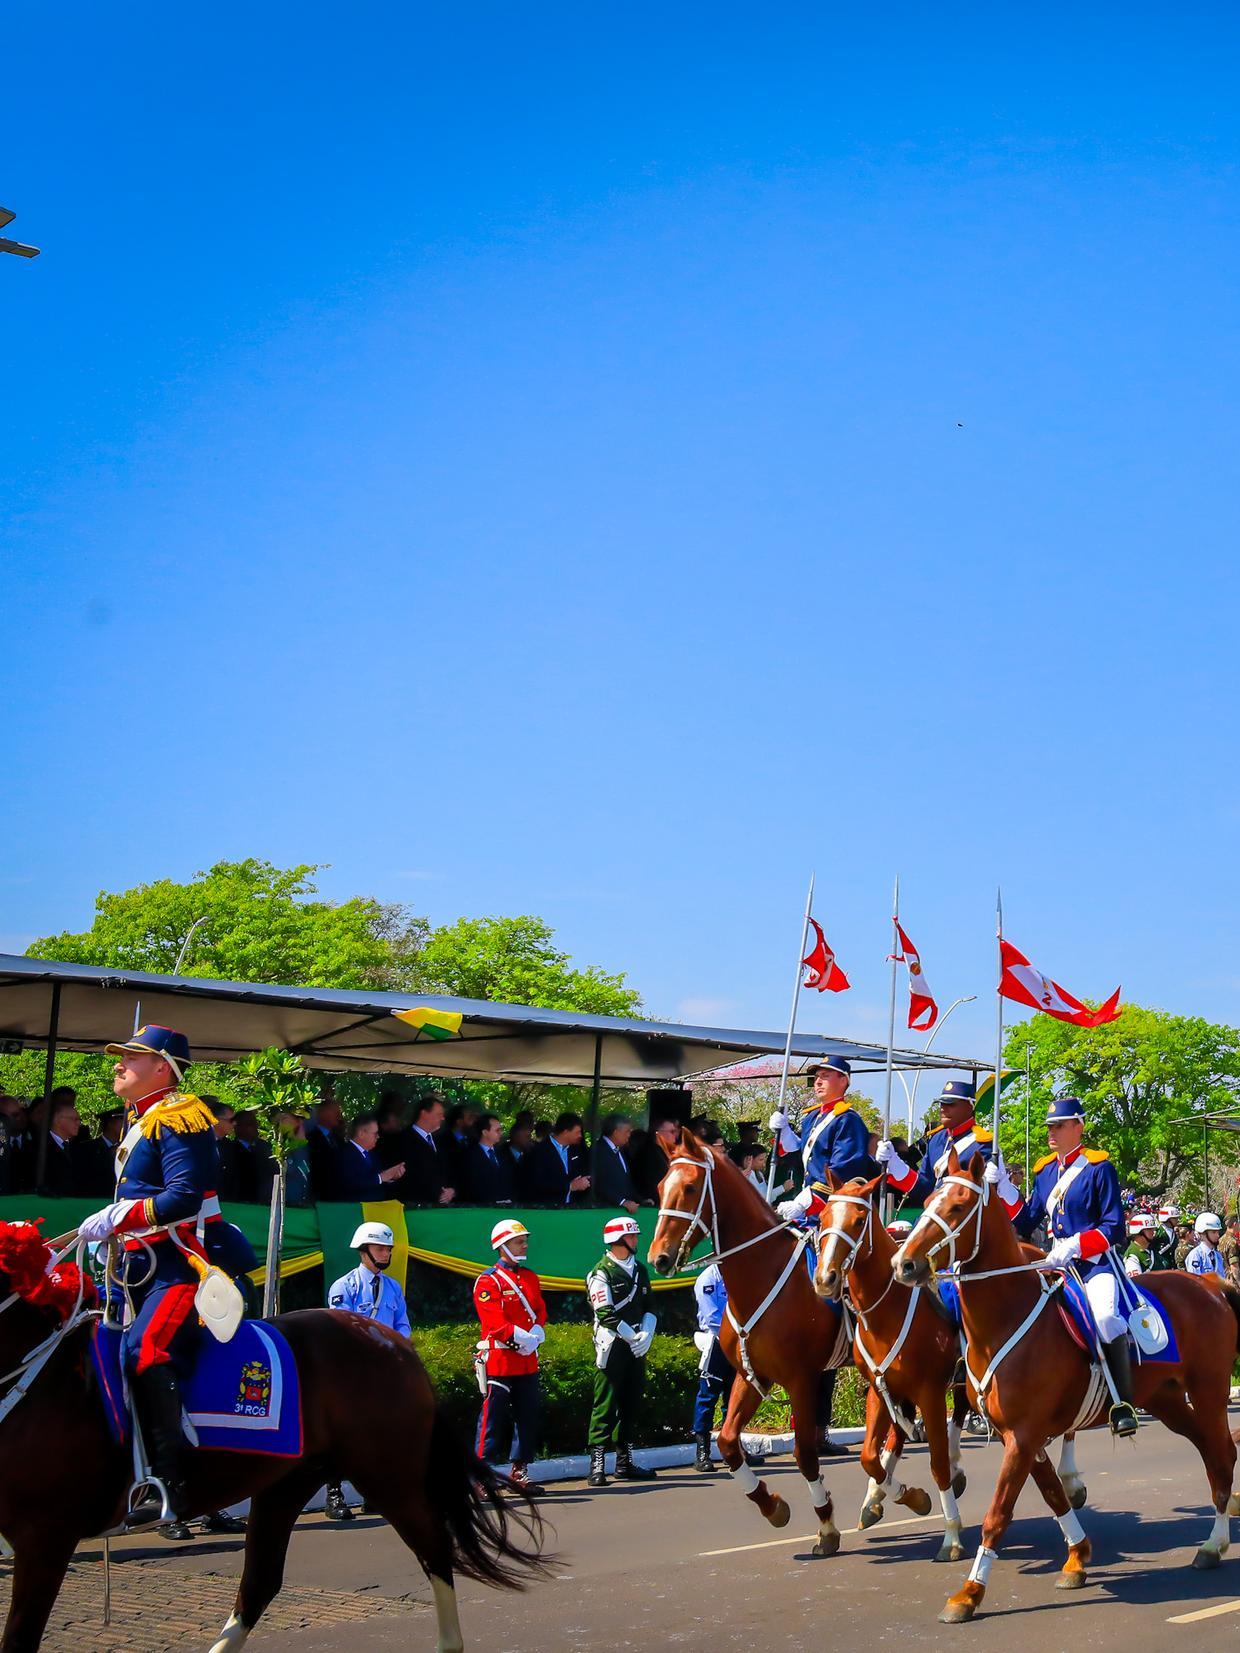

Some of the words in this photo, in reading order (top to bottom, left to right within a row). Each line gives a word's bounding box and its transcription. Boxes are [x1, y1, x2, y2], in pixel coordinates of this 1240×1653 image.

[1042, 992, 1052, 1006] 2
[591, 1290, 607, 1305] PE
[245, 1404, 266, 1416] RCG
